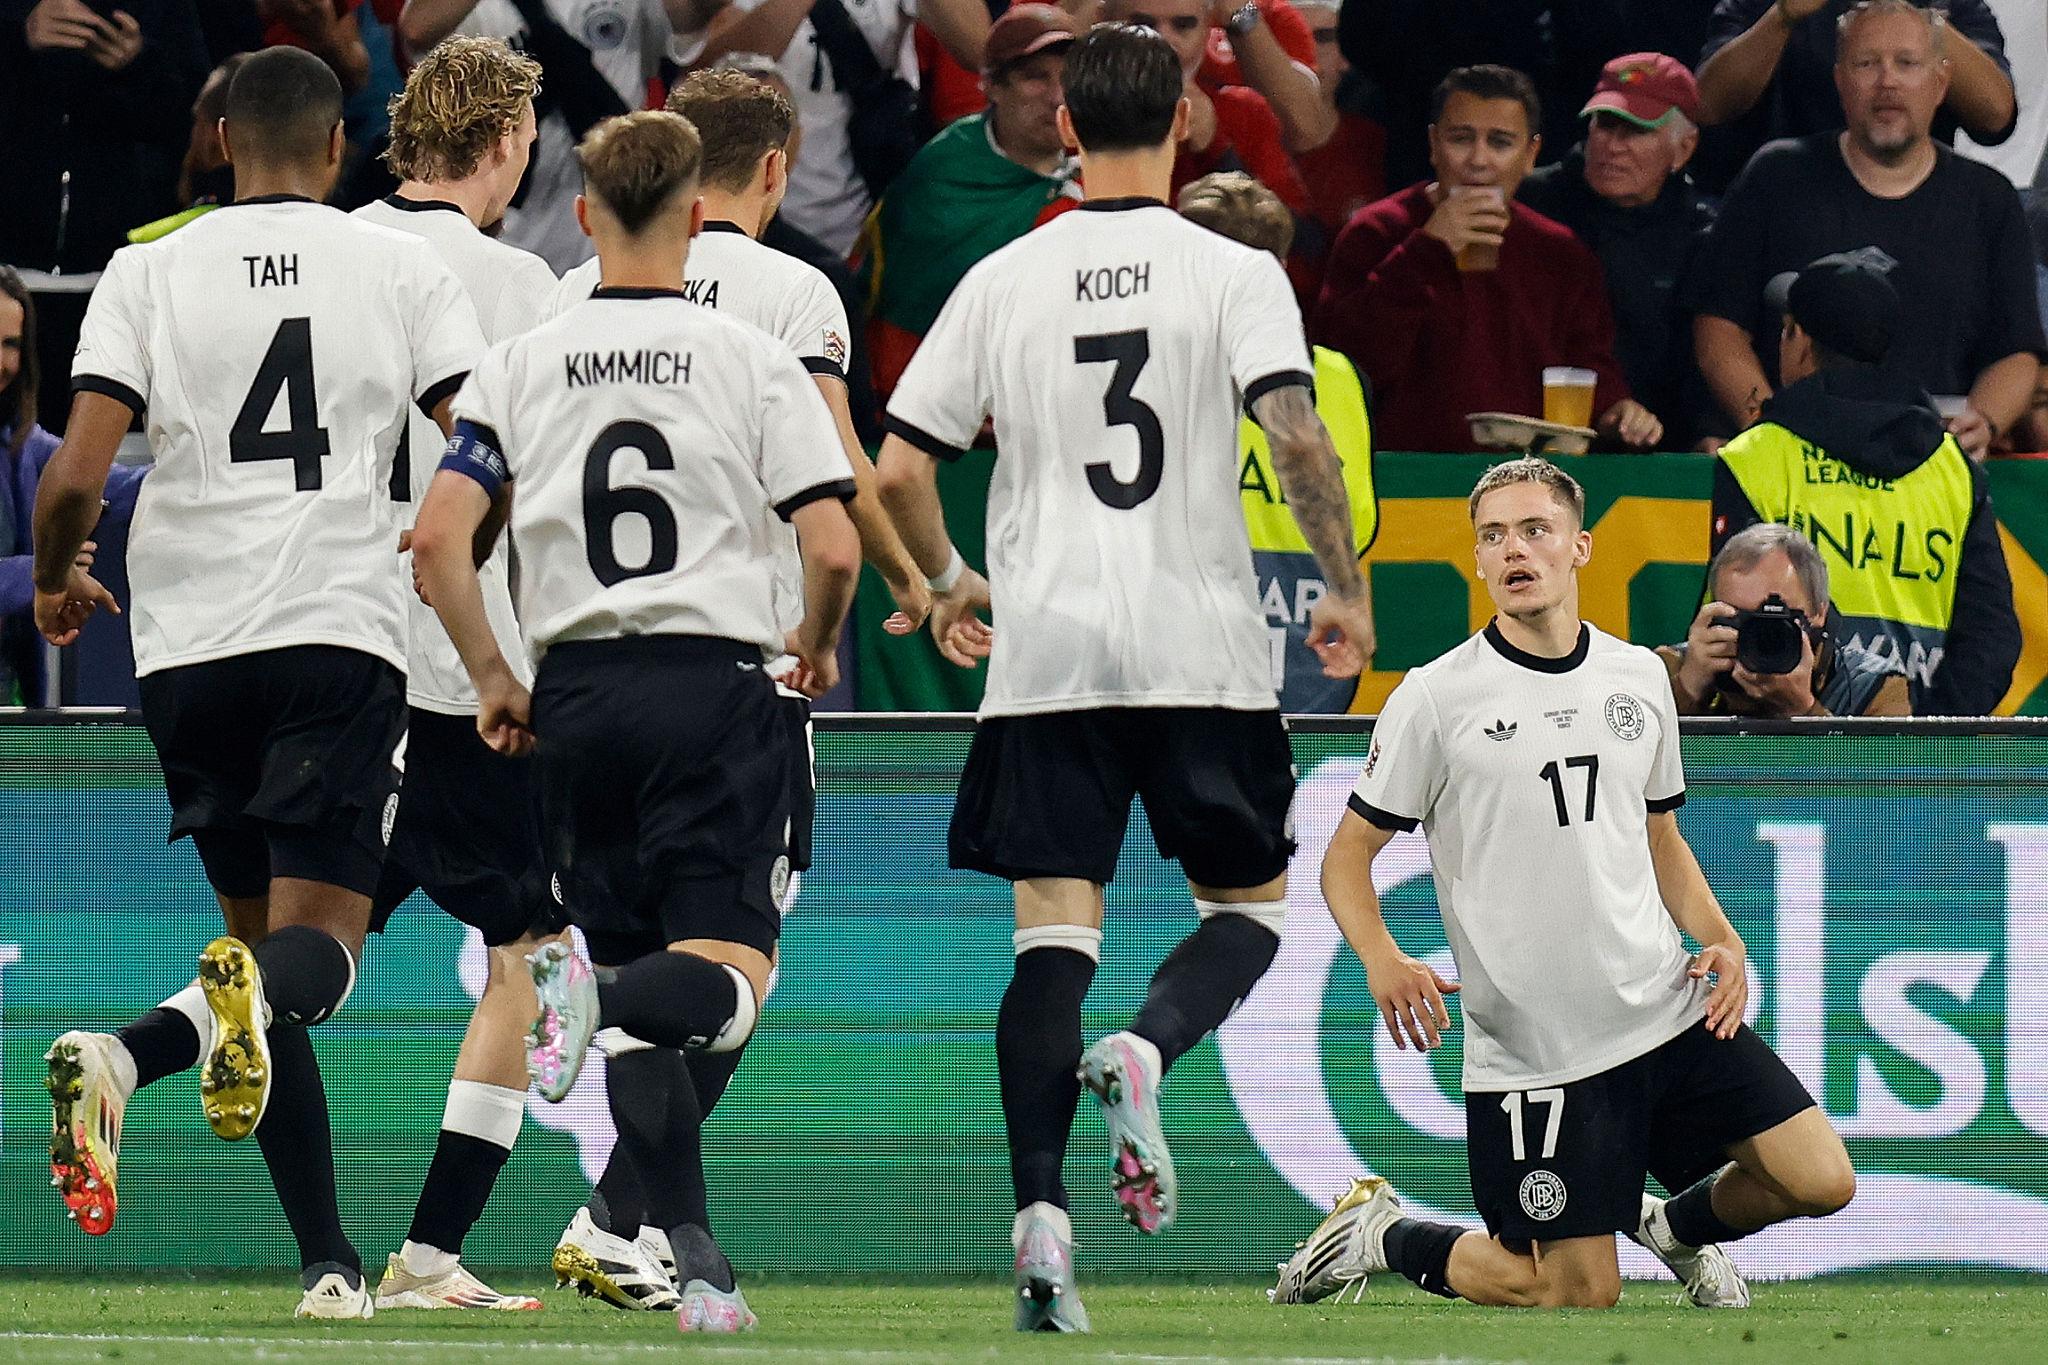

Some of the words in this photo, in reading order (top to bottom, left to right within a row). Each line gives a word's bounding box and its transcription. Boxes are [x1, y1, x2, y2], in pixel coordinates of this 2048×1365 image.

[243, 254, 298, 287] TAH
[1076, 262, 1150, 302] KOCH
[229, 316, 331, 492] 4
[565, 350, 691, 388] KIMMICH
[1073, 327, 1164, 510] 3
[583, 418, 678, 589] 6
[1539, 754, 1599, 827] 17
[1500, 1088, 1565, 1160] 17
